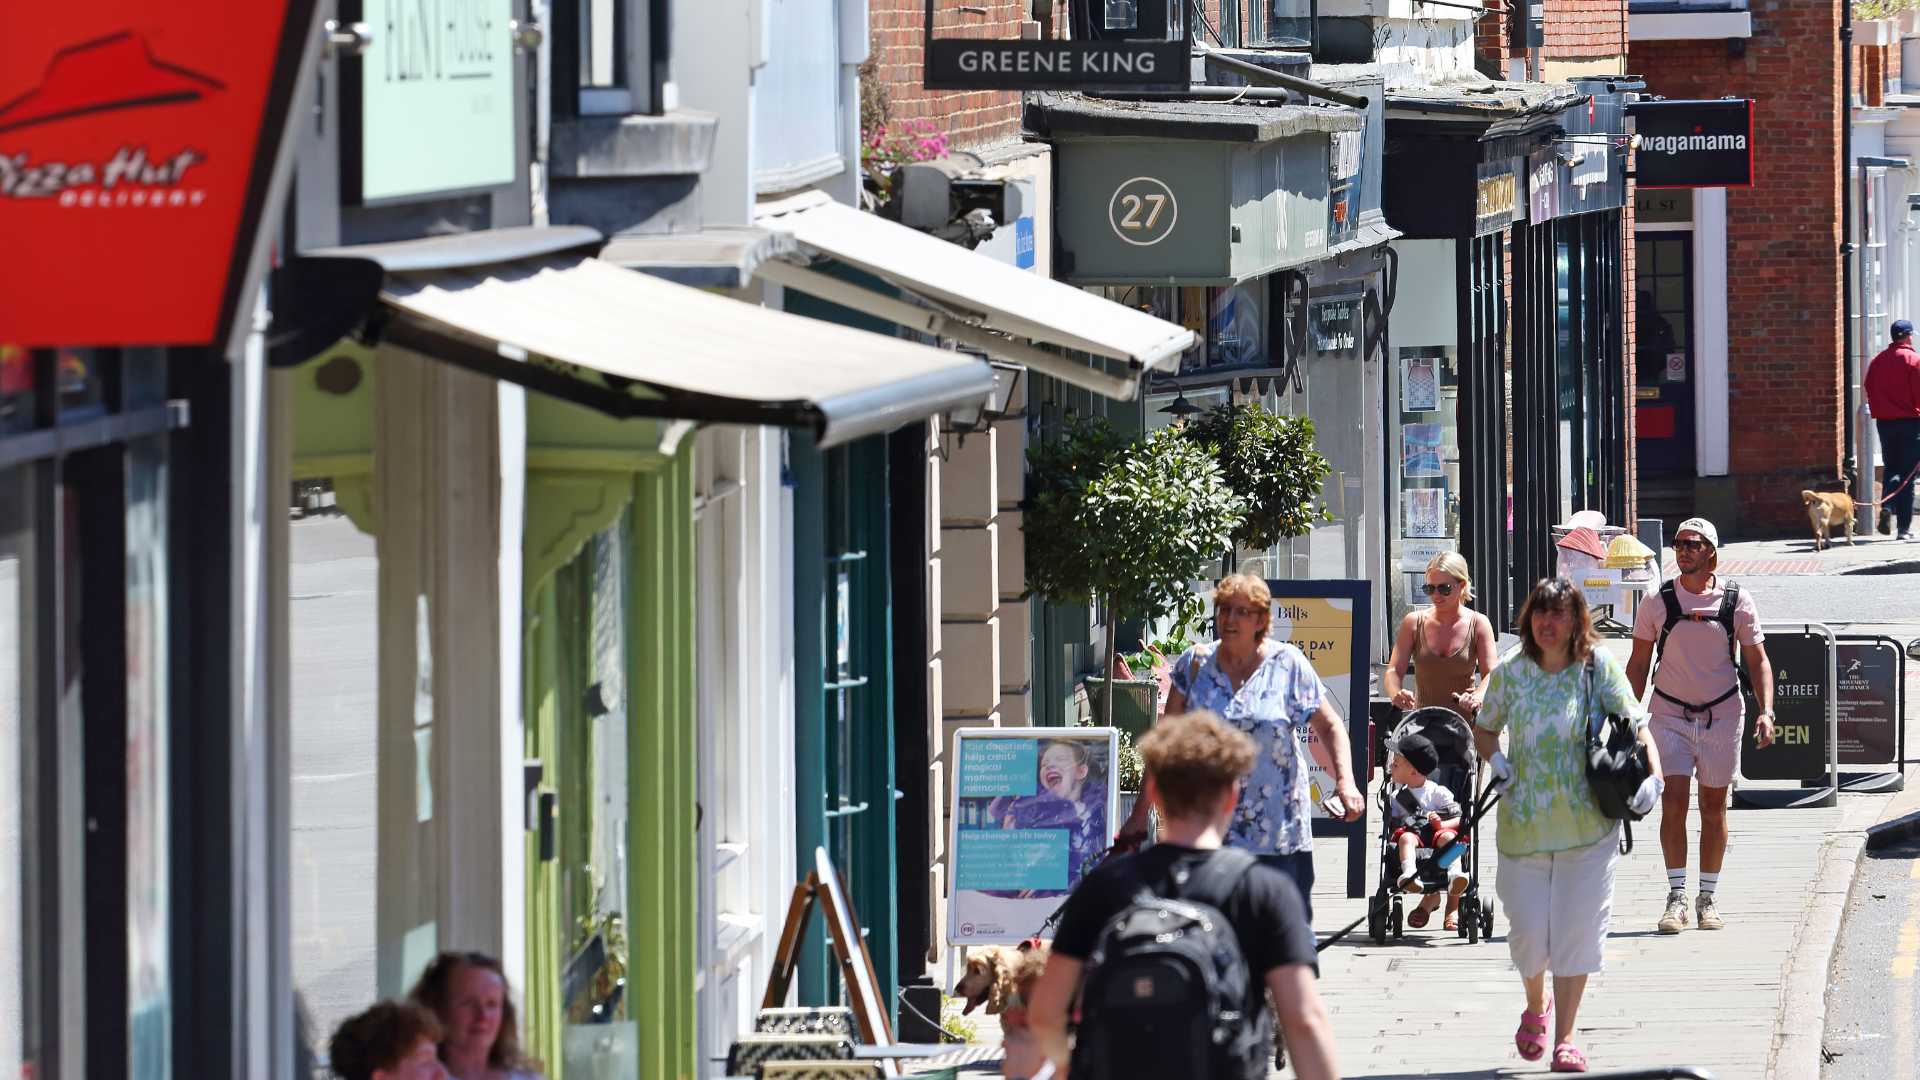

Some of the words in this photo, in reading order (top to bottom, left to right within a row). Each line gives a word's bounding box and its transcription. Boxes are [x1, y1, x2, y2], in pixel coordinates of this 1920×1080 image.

[958, 51, 1071, 72] GREENE
[1082, 52, 1155, 73] KING
[1641, 134, 1746, 155] wagamama
[0, 151, 97, 198] Pizza
[102, 146, 206, 191] Hut
[59, 189, 206, 208] DELIVERY
[1121, 194, 1167, 230] 27
[1310, 640, 1335, 650] DAY
[1778, 684, 1820, 697] STREET
[1756, 725, 1811, 745] PEN
[964, 752, 985, 763] help
